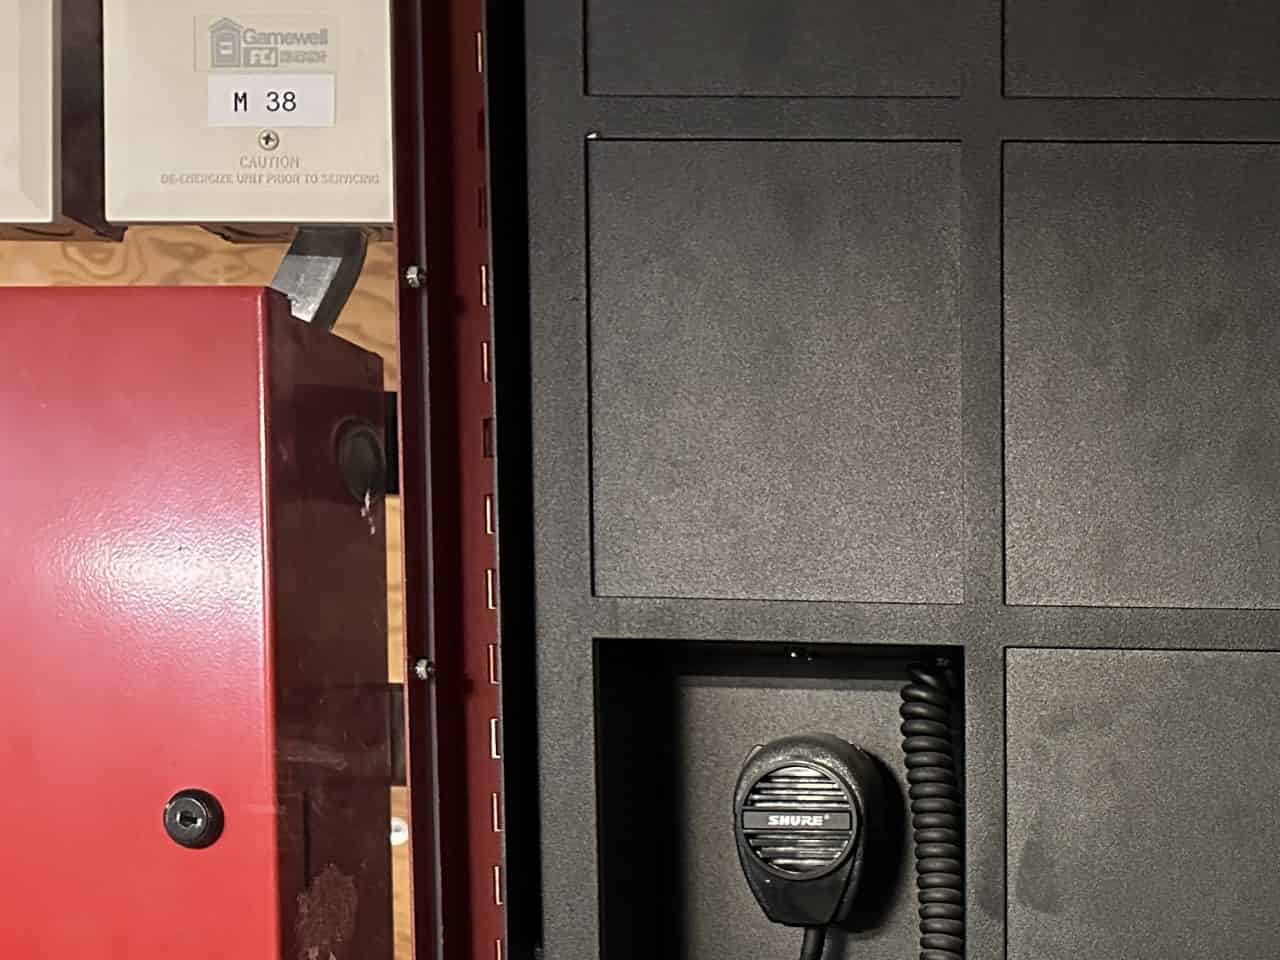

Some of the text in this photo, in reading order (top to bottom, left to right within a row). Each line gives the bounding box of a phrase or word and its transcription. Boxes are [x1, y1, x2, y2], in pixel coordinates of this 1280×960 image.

[243, 28, 328, 45] Gamewell
[234, 91, 297, 112] M 38
[239, 156, 300, 169] CAUTION
[305, 174, 318, 185] TO
[768, 815, 823, 826] SHURE
